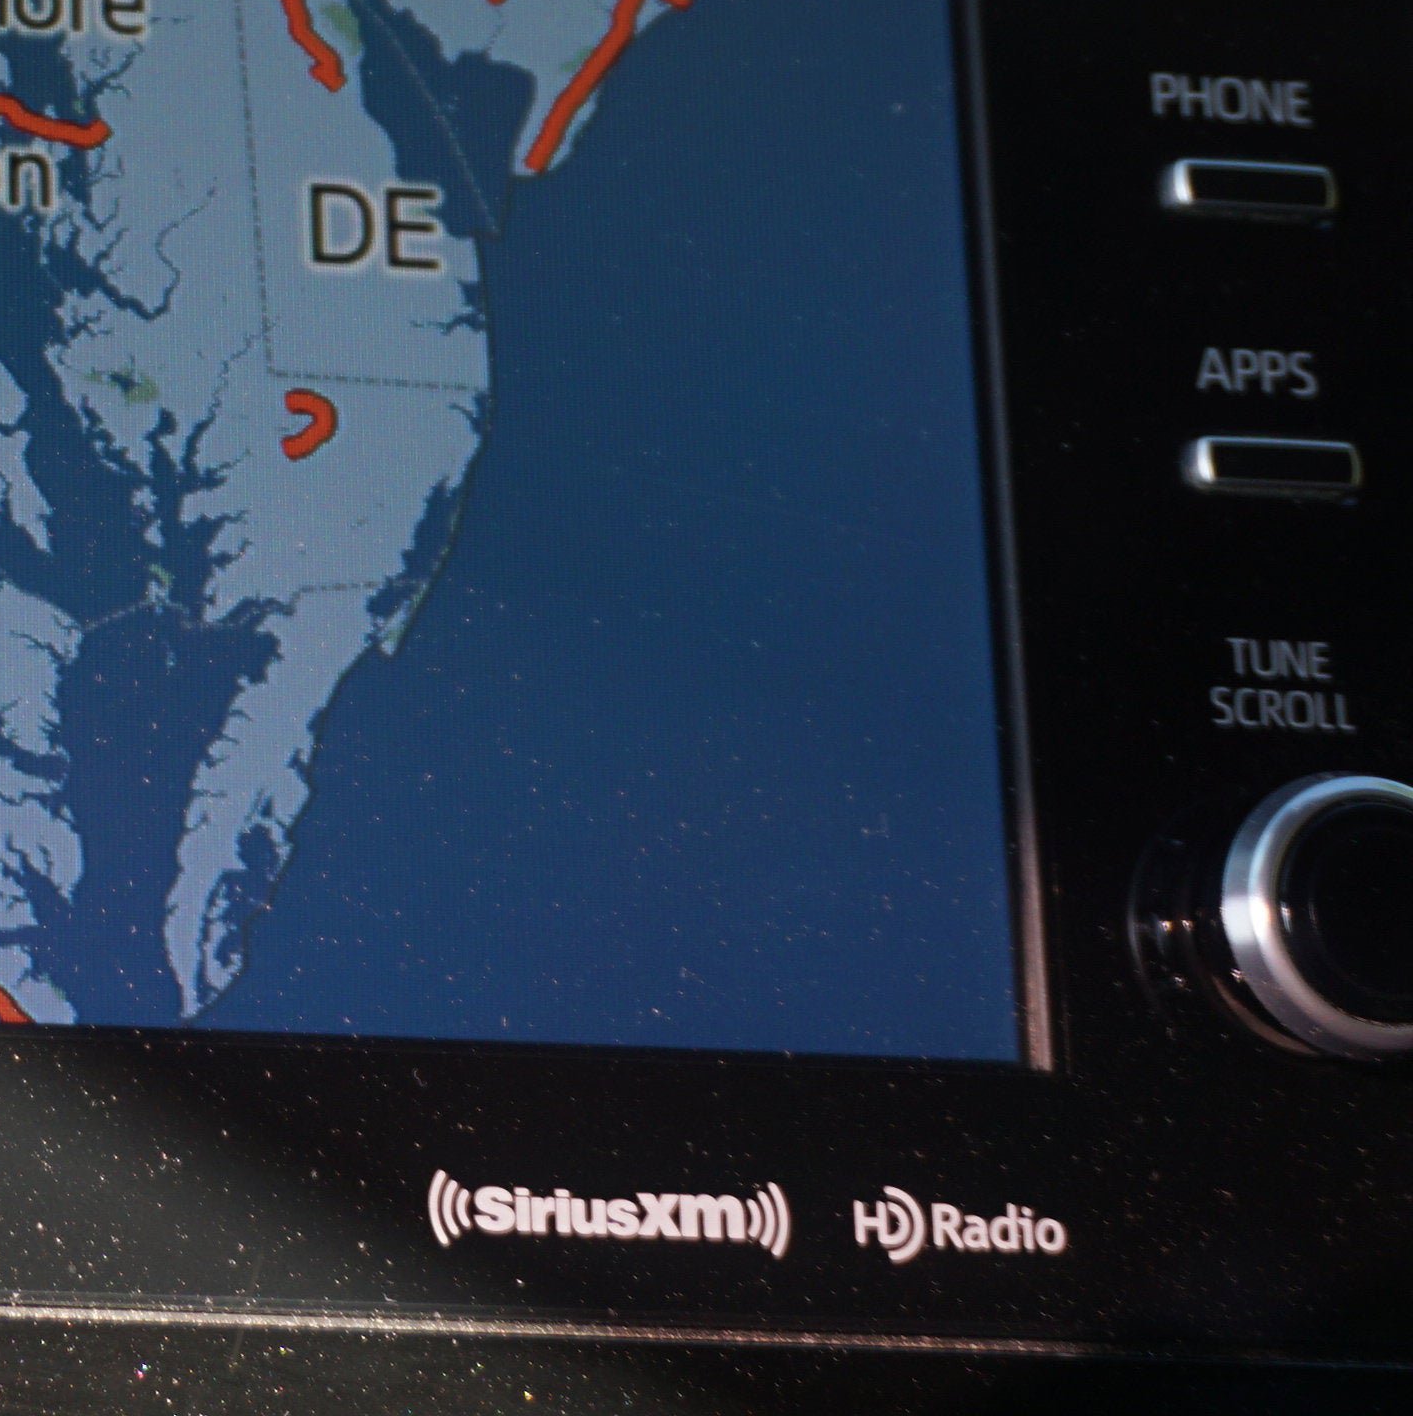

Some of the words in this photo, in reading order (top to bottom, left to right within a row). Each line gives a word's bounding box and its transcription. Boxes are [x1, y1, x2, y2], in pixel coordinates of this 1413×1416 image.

[1150, 72, 1313, 126] PHONE
[309, 184, 443, 271] DE
[1196, 347, 1318, 397] APPS
[1226, 637, 1331, 681] TUNE
[1209, 686, 1356, 730] SCROLL
[854, 1186, 926, 1263] HD
[933, 1203, 1067, 1254] Radio
